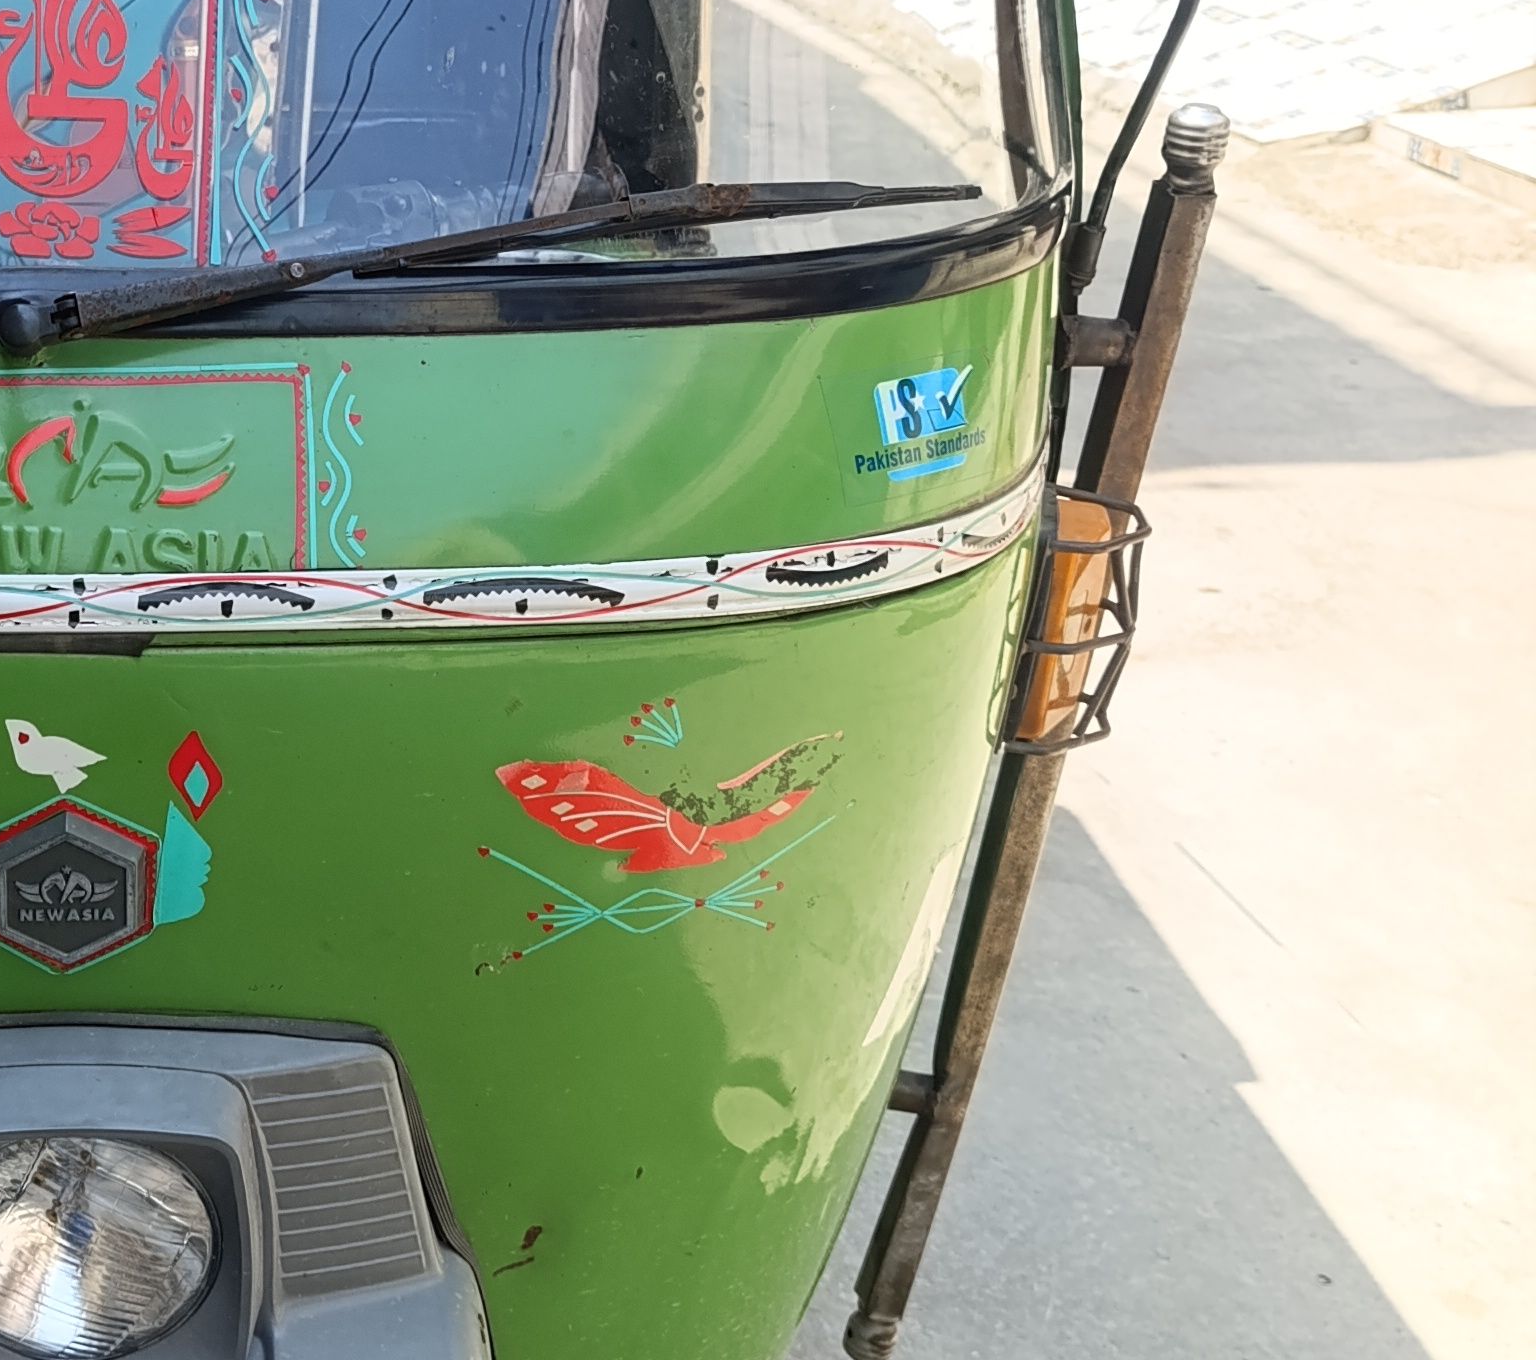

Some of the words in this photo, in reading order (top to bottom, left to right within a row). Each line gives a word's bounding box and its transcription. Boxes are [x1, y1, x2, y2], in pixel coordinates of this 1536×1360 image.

[854, 446, 922, 475] Pakistan
[925, 427, 986, 459] Standards
[82, 525, 279, 573] ASIA
[19, 909, 65, 922] NEW
[66, 908, 115, 922] ASIA
